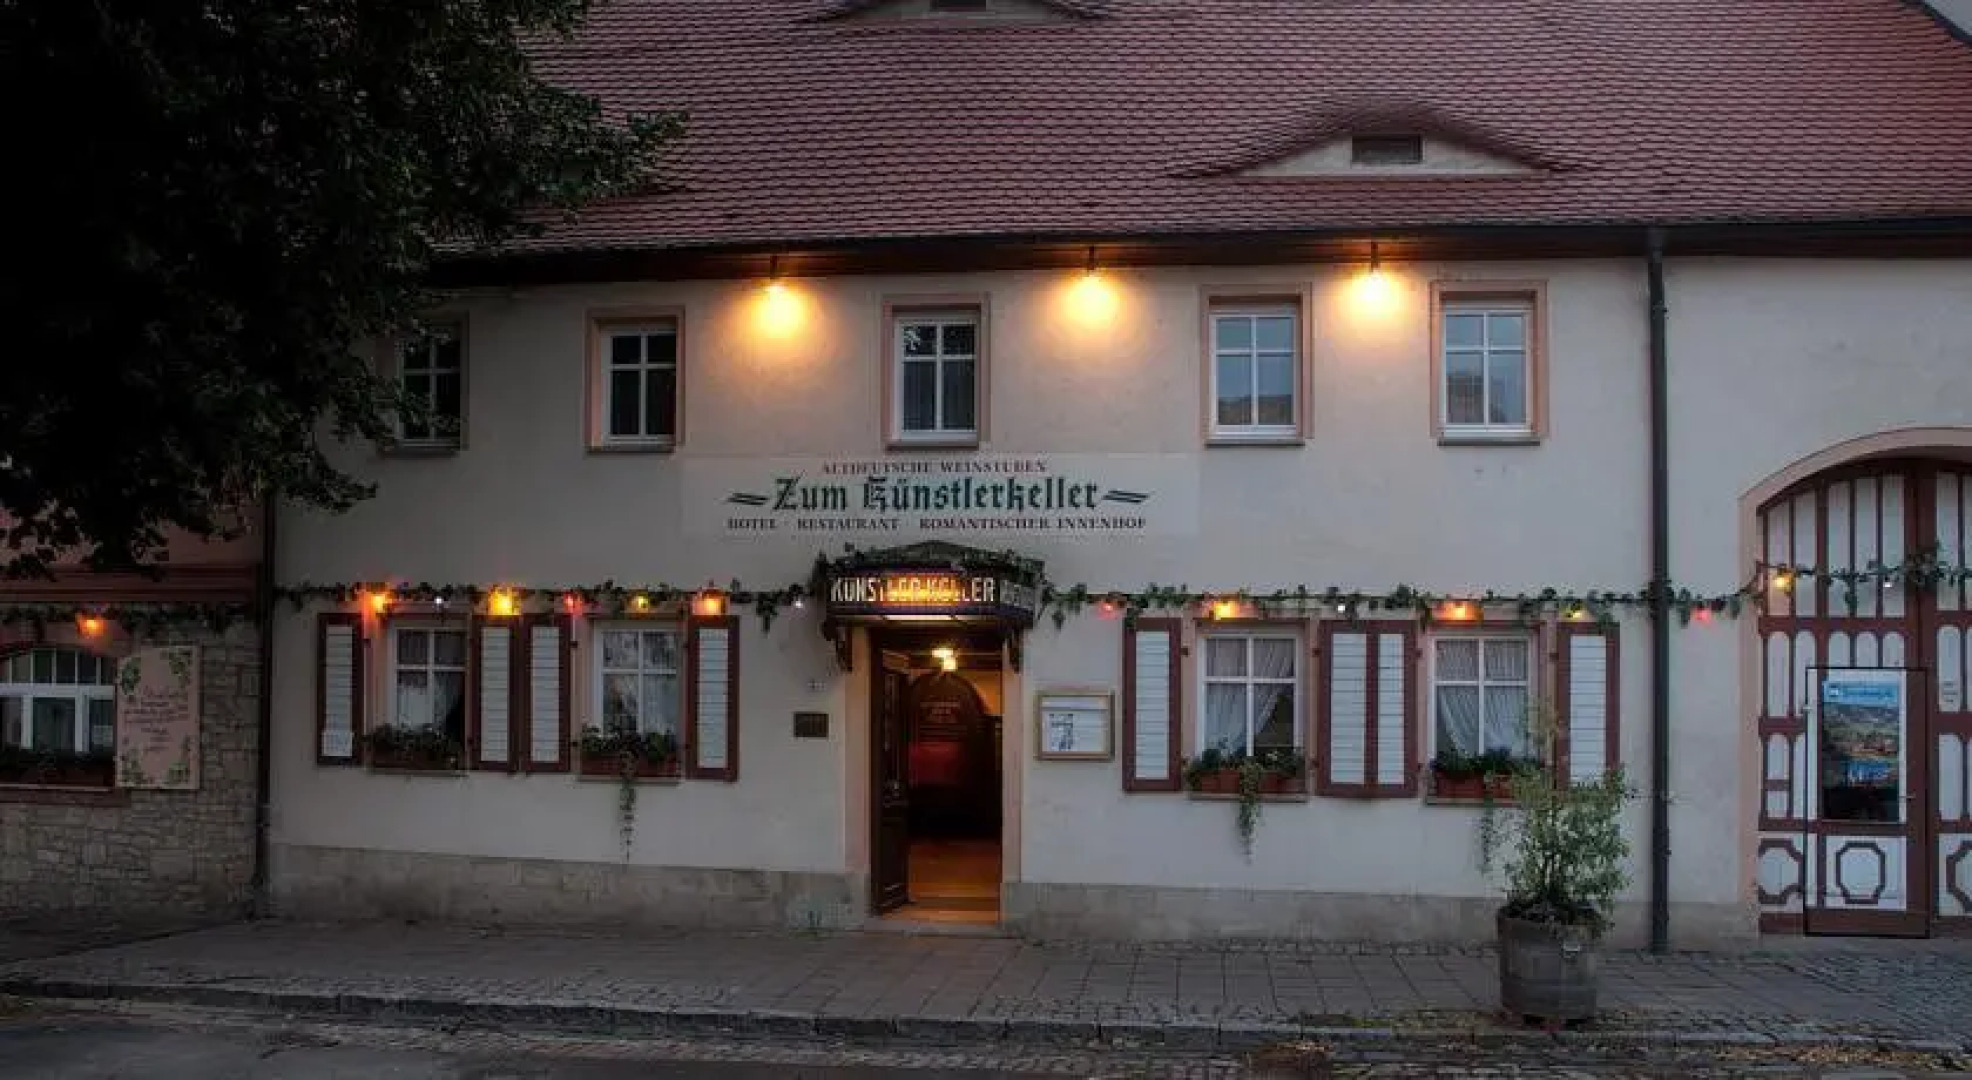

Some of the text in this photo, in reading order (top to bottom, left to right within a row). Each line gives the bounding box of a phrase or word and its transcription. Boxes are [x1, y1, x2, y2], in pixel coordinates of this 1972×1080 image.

[940, 461, 1048, 473] WEINSTUBEN
[772, 472, 1098, 512] Zum Künstlerkeller
[728, 518, 1147, 529] HOTEL RESTAURANT ROMANTISCHER INNENHOF
